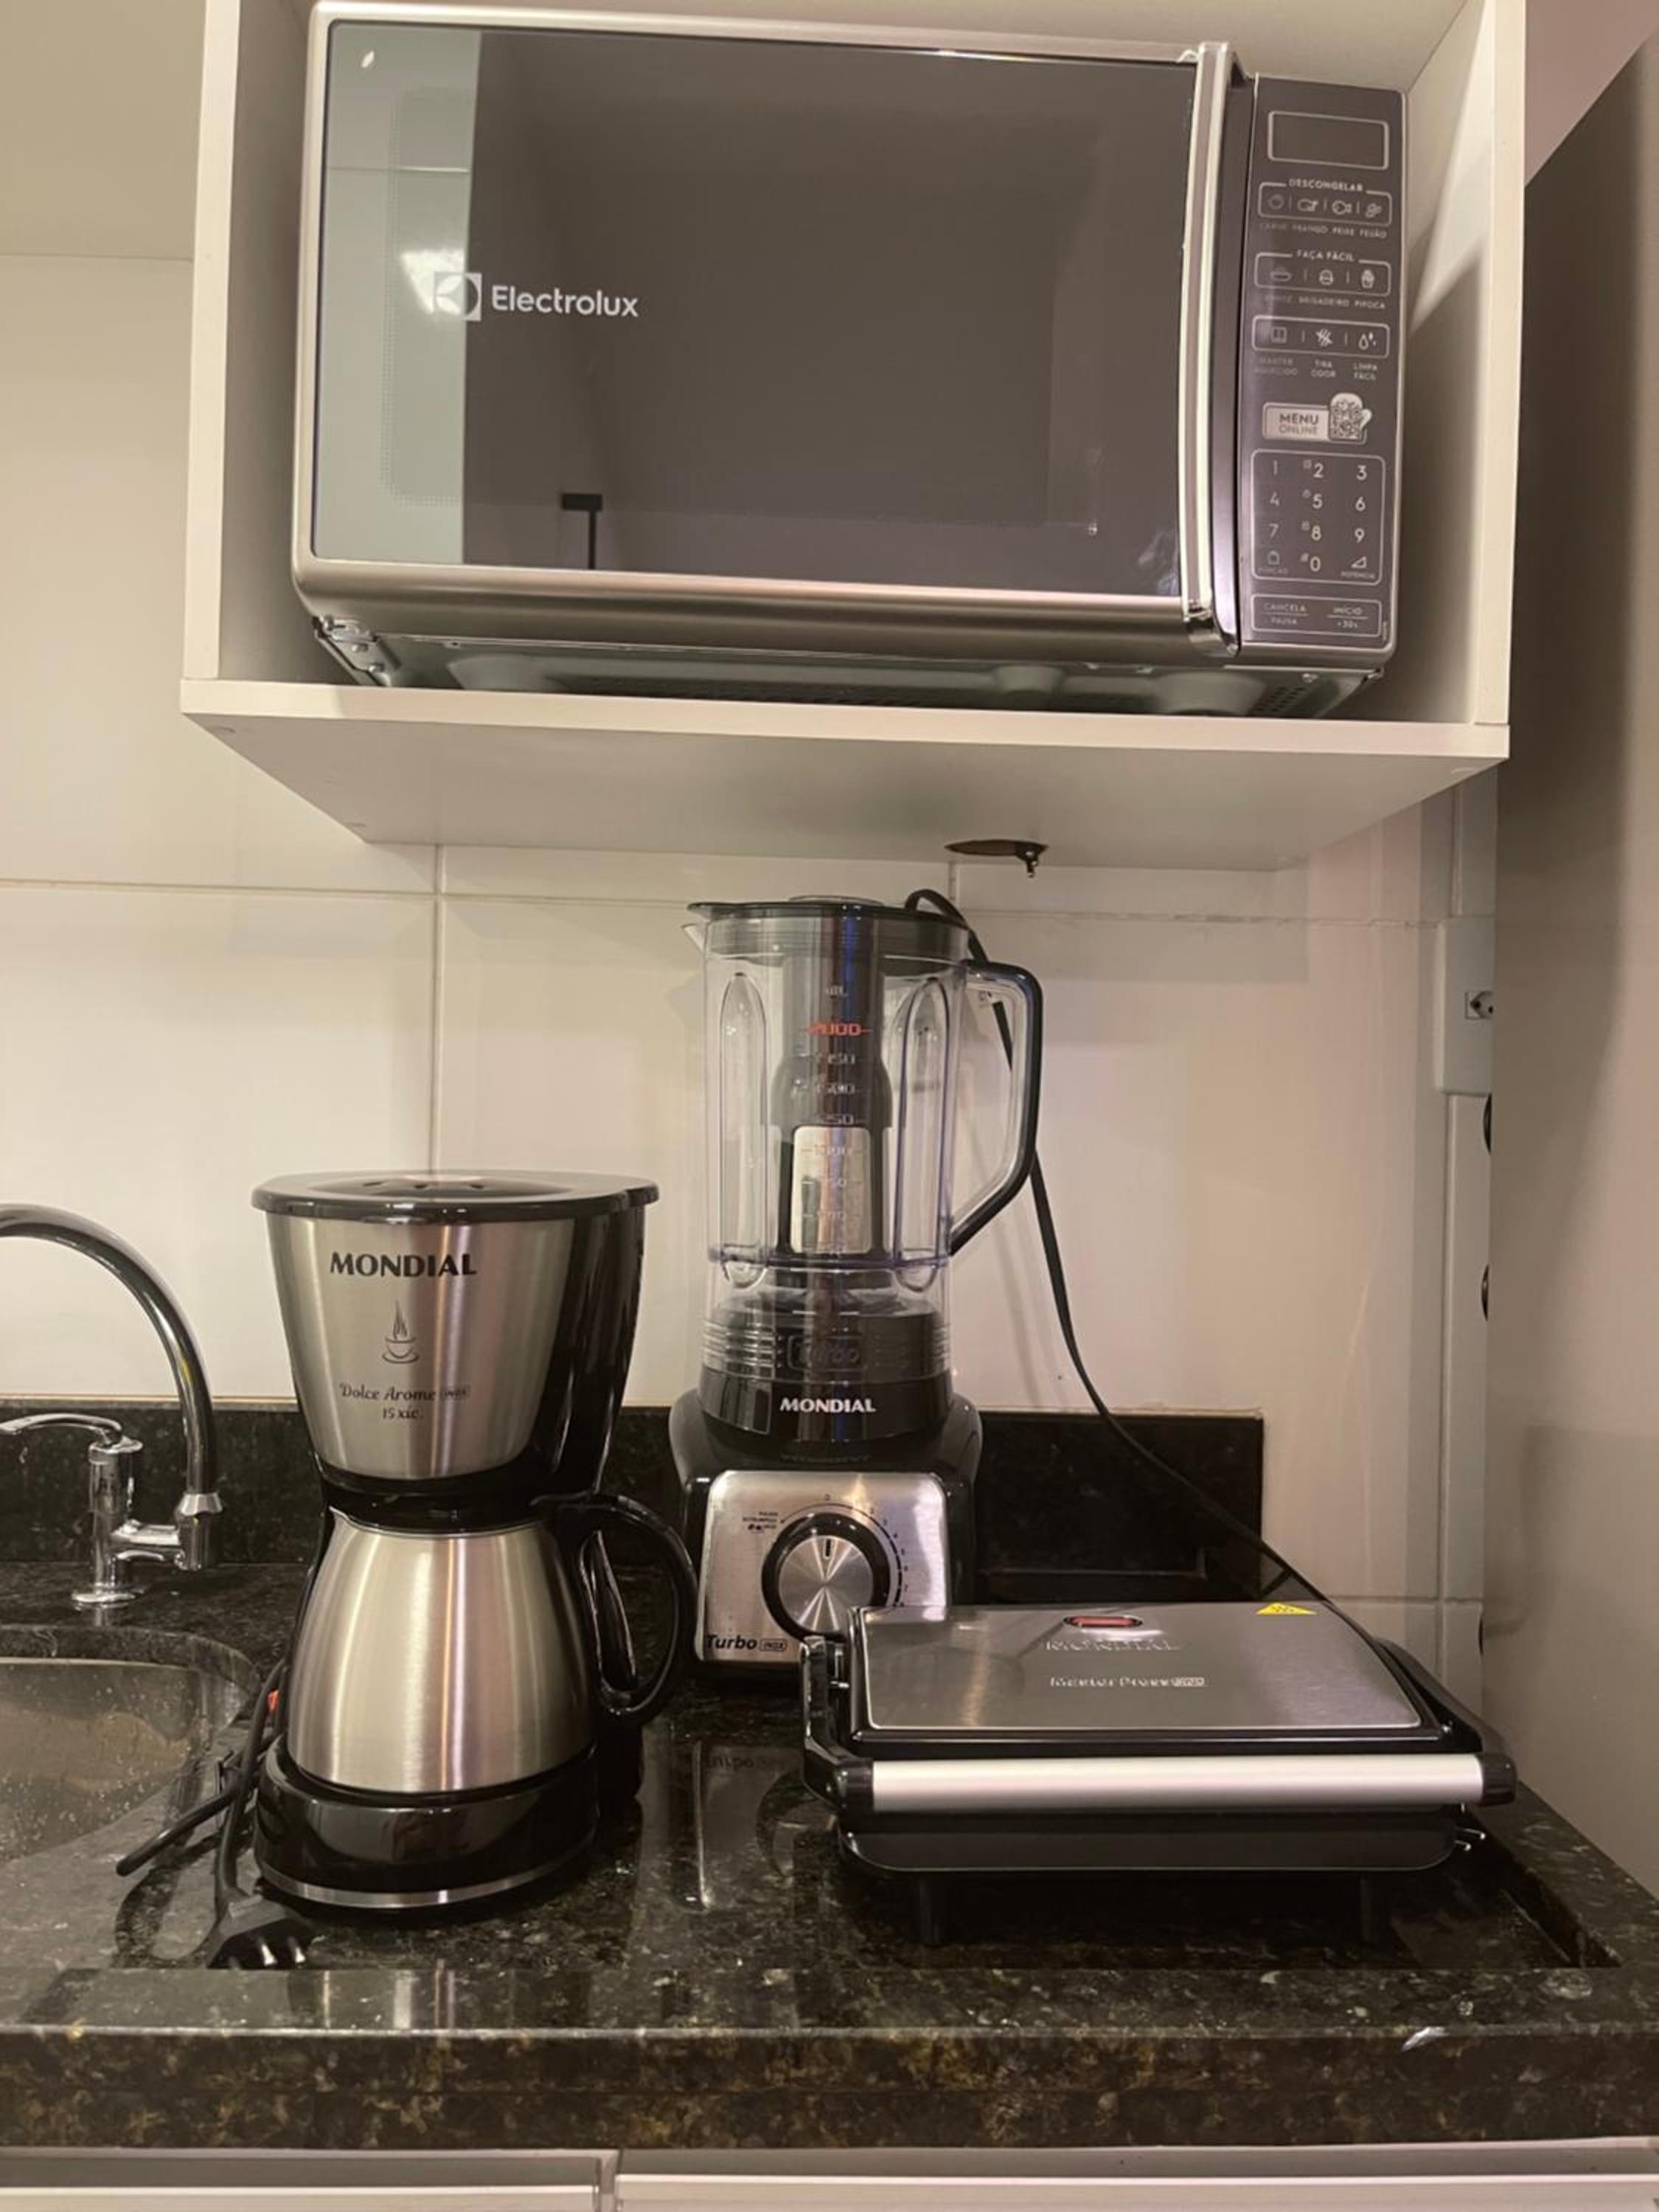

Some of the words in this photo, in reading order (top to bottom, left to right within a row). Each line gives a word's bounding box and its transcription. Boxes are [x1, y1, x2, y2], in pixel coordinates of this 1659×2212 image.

[1289, 178, 1363, 192] DESCONGELAR
[1297, 249, 1324, 260] FAÇA
[1326, 251, 1354, 262] FÁCIL
[492, 285, 639, 317] Electrolux
[1279, 413, 1319, 424] MENU
[1279, 424, 1318, 434] ONLINE
[1273, 460, 1278, 476] 1
[1313, 463, 1324, 479] 2
[1356, 465, 1367, 481] 3
[1270, 492, 1280, 506] 4
[1312, 493, 1323, 509] 5
[1355, 496, 1366, 511] 6
[1269, 524, 1279, 538] 7
[1311, 525, 1321, 540] 8
[1354, 528, 1365, 543] 9
[1310, 557, 1321, 572] 0
[1263, 602, 1307, 612] CANCELA
[330, 1251, 478, 1277] MONDIAL
[339, 1382, 379, 1400] Dolce
[779, 1398, 876, 1413] MONDIAL
[707, 1635, 757, 1649] Turbo
